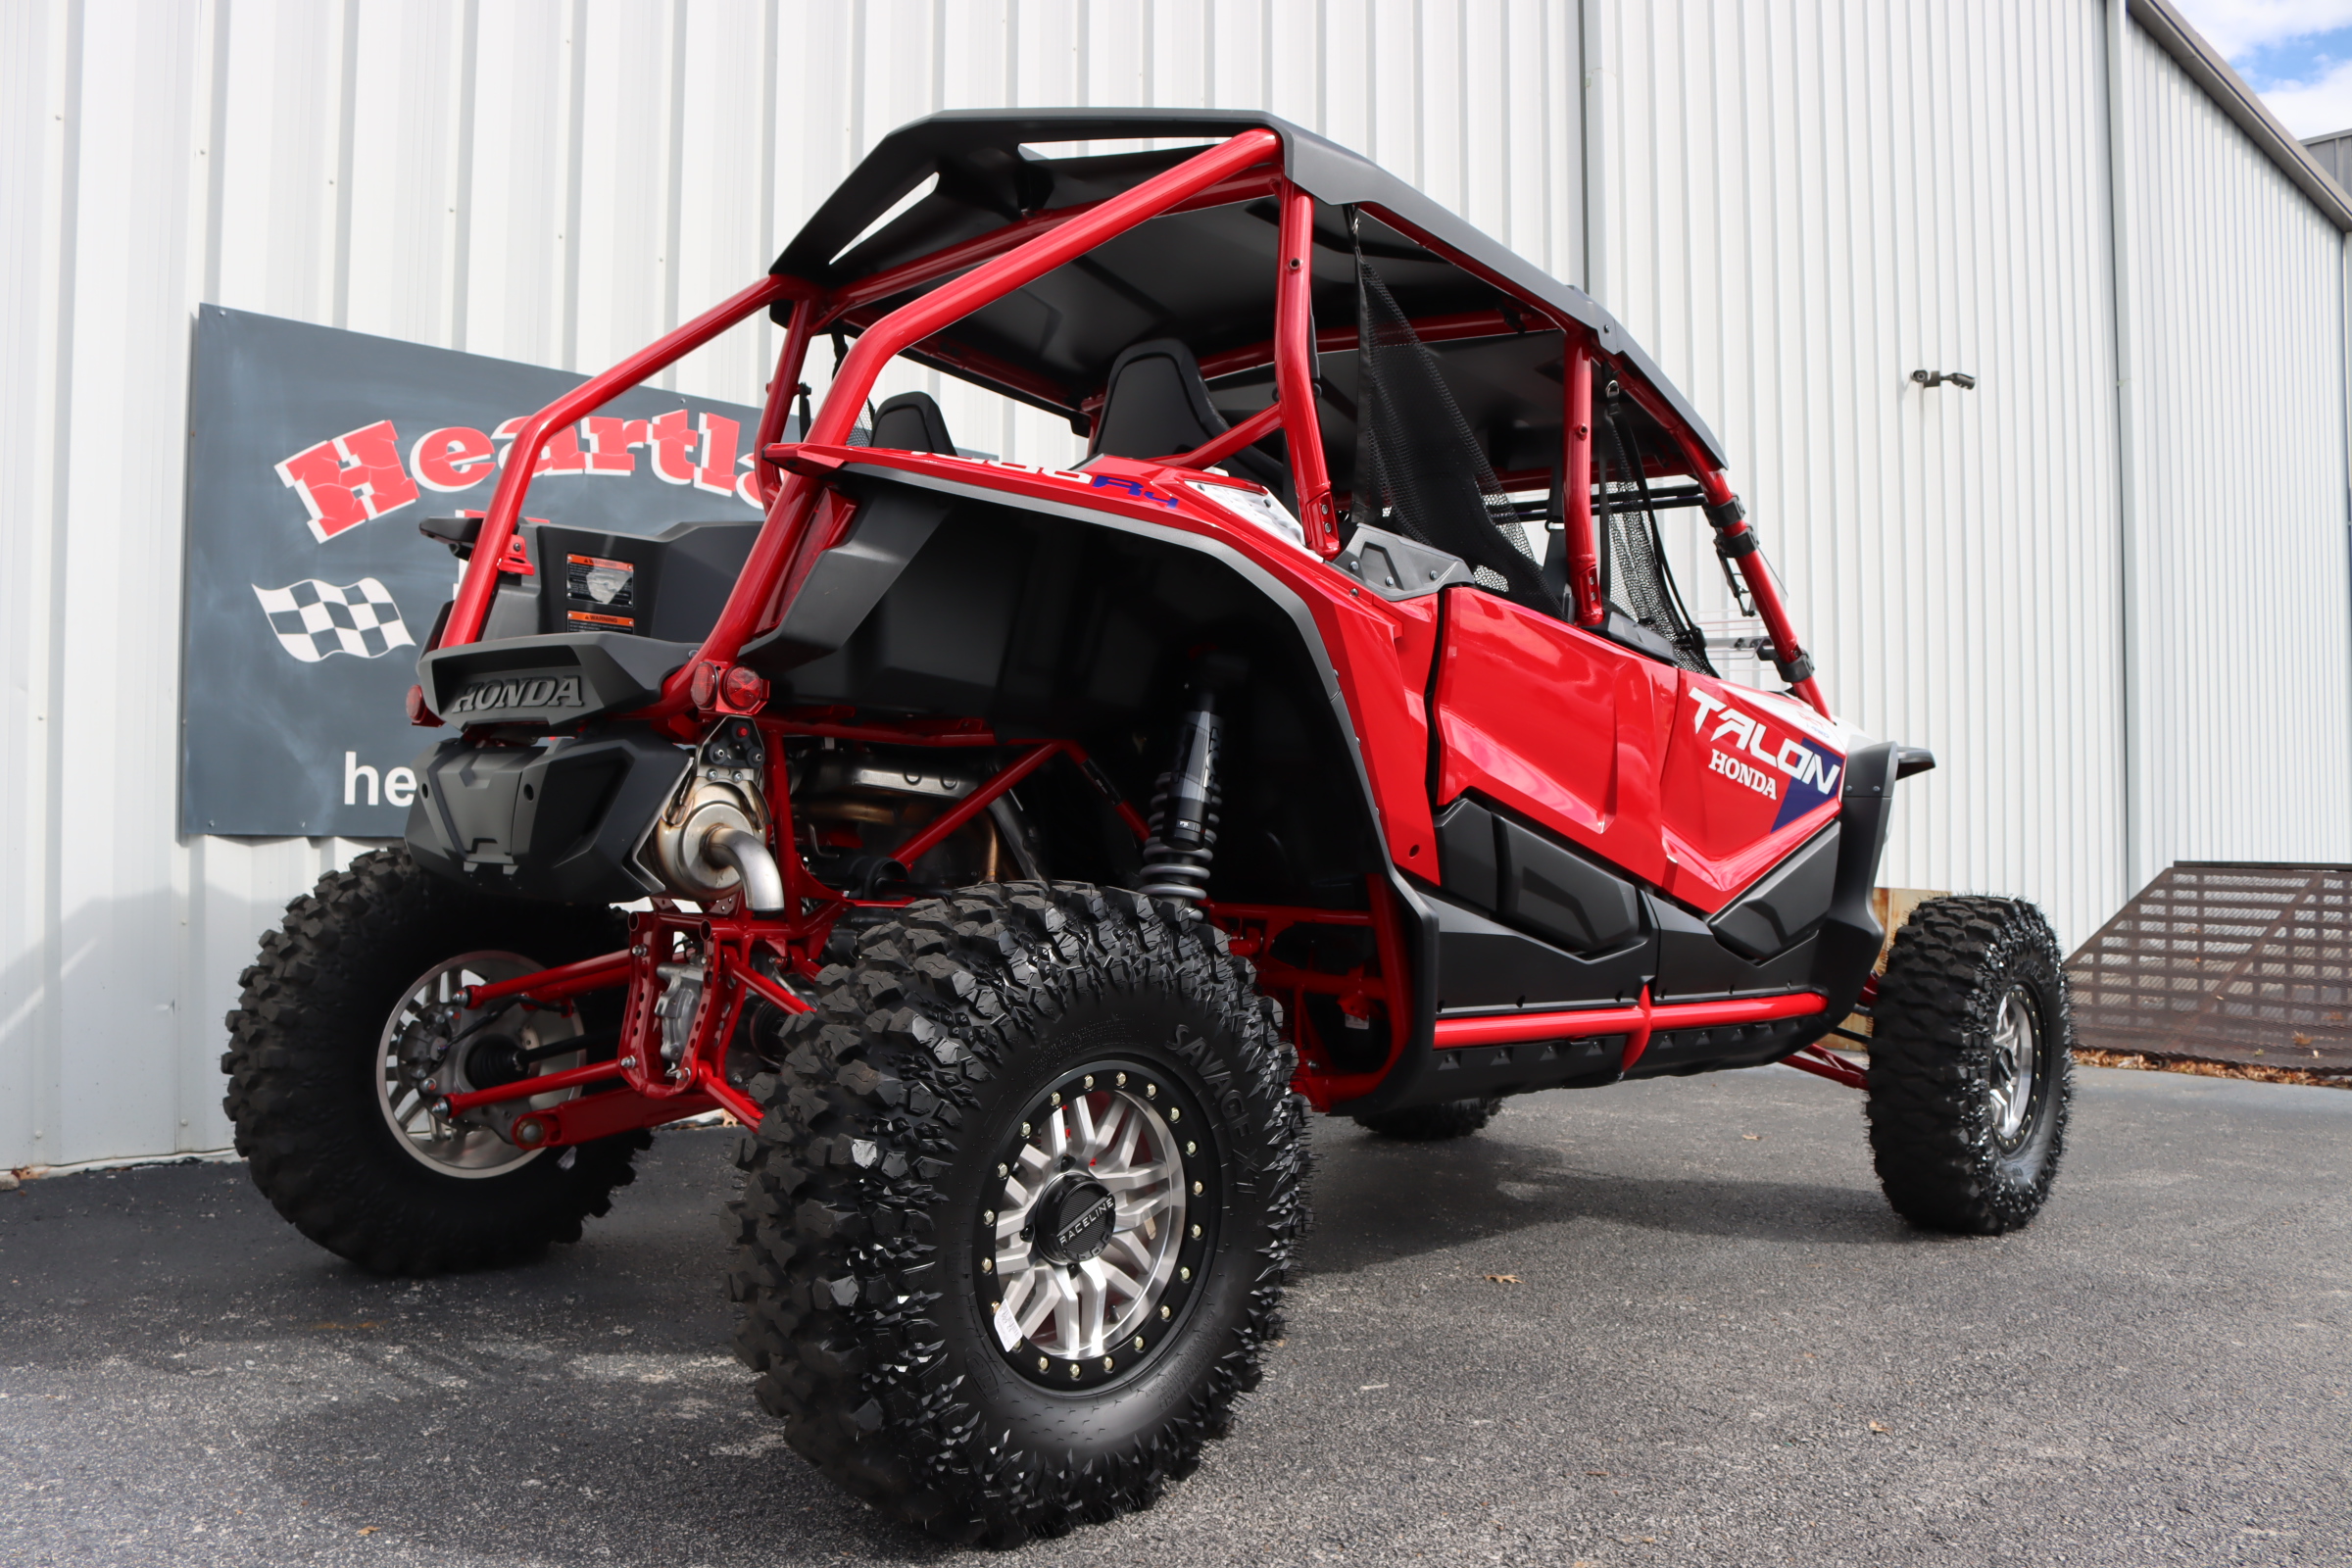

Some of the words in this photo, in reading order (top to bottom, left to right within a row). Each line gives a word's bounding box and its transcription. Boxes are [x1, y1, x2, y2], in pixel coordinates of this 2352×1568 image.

[273, 409, 786, 544] Heartl
[589, 558, 616, 566] WARNING
[590, 614, 617, 623] WARNING
[451, 674, 586, 713] HONDA
[1688, 686, 1841, 795] TALON
[1708, 748, 1777, 801] HONDA
[1164, 1024, 1253, 1143] SAVAGE
[1058, 1198, 1114, 1248] RACELINE
